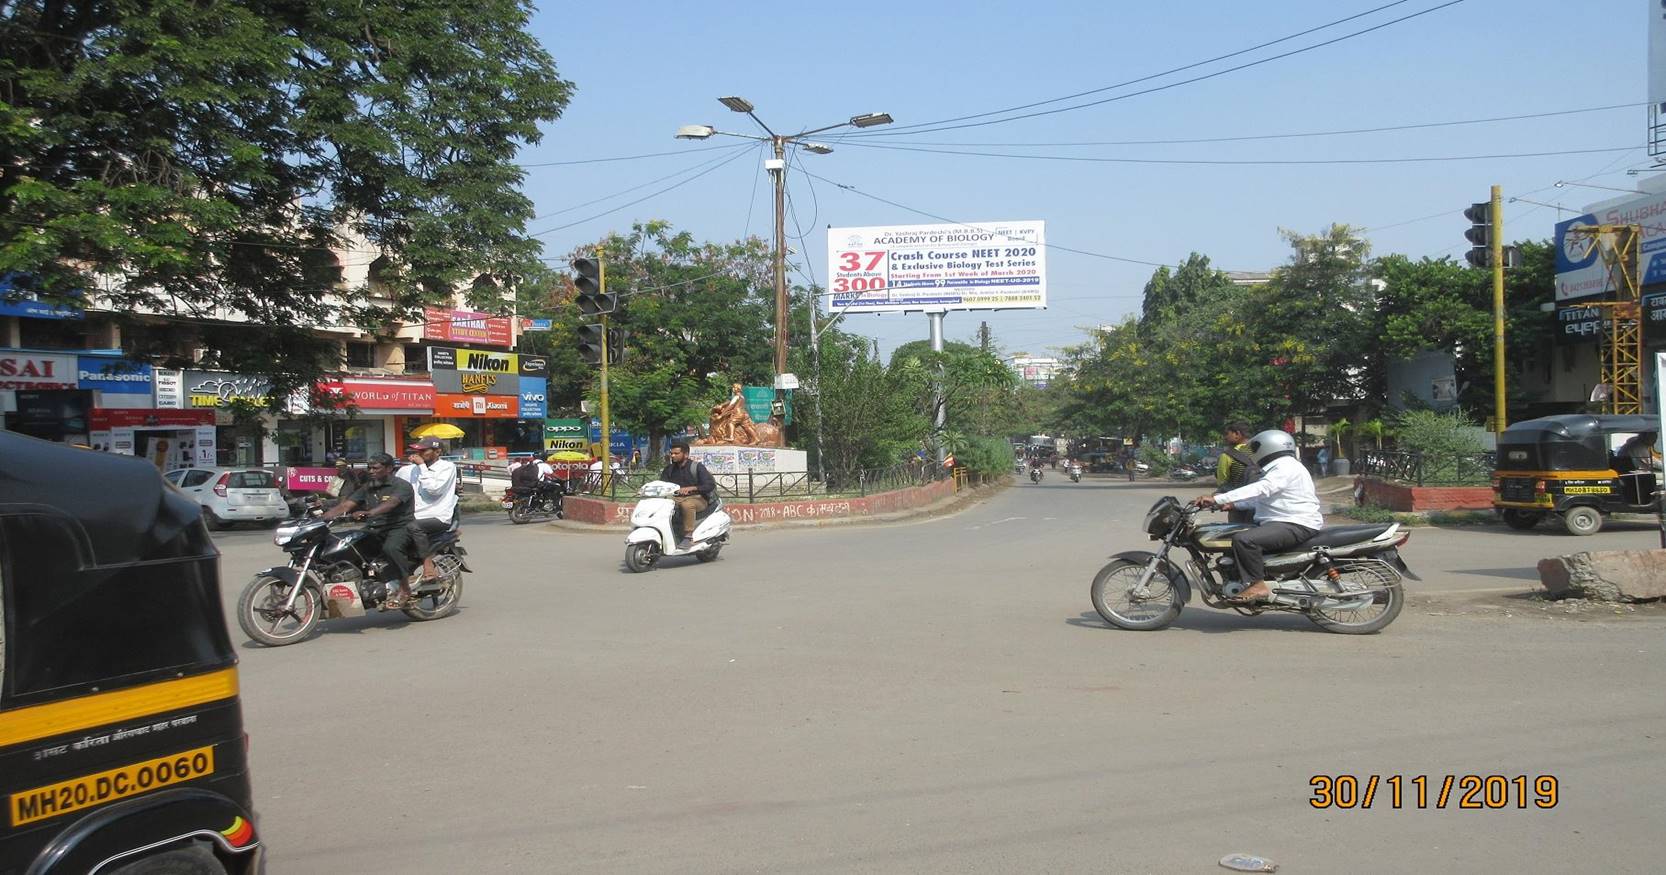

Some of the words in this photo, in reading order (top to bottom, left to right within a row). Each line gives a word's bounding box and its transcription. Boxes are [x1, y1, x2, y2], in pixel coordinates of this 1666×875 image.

[874, 235, 926, 245] ACADEMY
[930, 234, 945, 244] OF
[948, 233, 994, 243] BIOLOGY
[891, 251, 923, 261] Crash
[928, 250, 967, 259] Course
[972, 248, 999, 258] NEET
[1004, 247, 1036, 257] 2020
[839, 251, 886, 272] 37
[902, 261, 943, 270] Exclusive
[947, 260, 982, 270] Biology
[986, 259, 1004, 268] Test
[1007, 258, 1036, 267] Series
[891, 272, 920, 280] Starting
[834, 277, 885, 292] 300
[935, 279, 946, 287] 99
[1565, 309, 1601, 321] TITAN
[0, 358, 55, 378] SAI
[468, 353, 509, 371] Nikon
[79, 370, 151, 382] Panasonic
[192, 395, 223, 406] TIME
[353, 391, 389, 401] WORLD
[391, 391, 399, 402] of
[402, 392, 432, 401] TITAN
[550, 440, 583, 449] Nikon
[552, 462, 589, 471] otorola
[300, 475, 316, 483] CUTS
[317, 475, 324, 483] &
[17, 751, 208, 822] MH20.DC.0060
